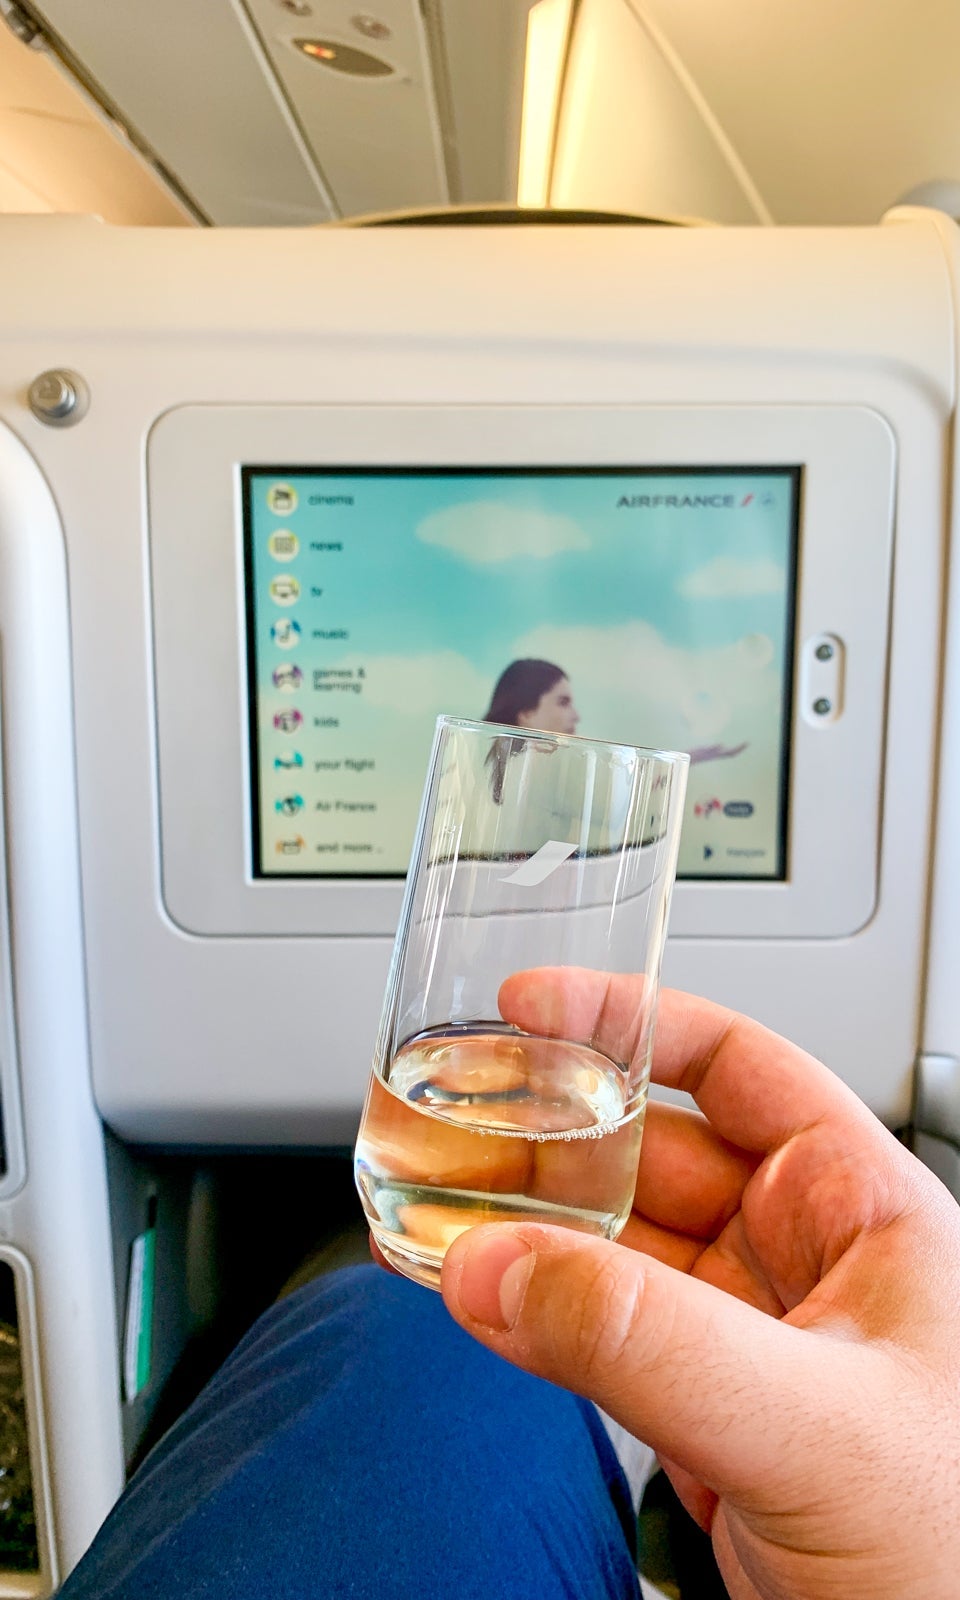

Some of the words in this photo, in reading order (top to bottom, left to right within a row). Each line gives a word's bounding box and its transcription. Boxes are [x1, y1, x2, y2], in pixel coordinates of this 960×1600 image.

[308, 495, 354, 505] cinema
[310, 541, 343, 551] news
[312, 629, 348, 640] music
[313, 669, 353, 681] games
[314, 681, 362, 693] learning
[314, 717, 339, 728] kids
[315, 760, 341, 771] your
[344, 758, 376, 771] flight
[316, 801, 331, 811] Air
[335, 800, 376, 811] France
[316, 843, 339, 853] and
[342, 844, 373, 853] more
